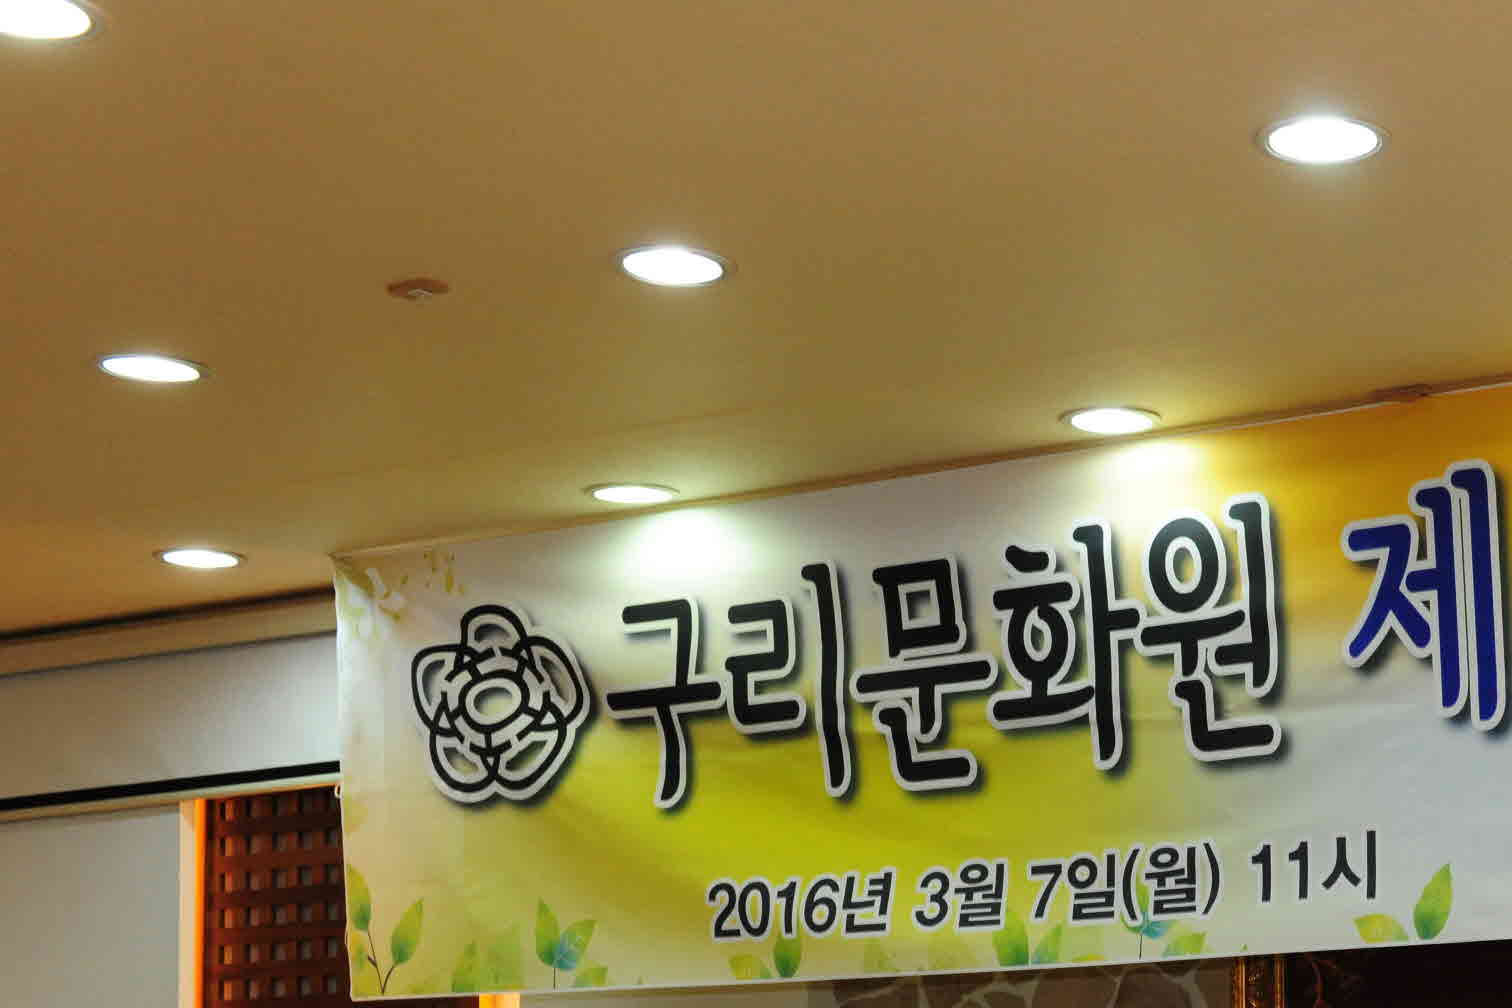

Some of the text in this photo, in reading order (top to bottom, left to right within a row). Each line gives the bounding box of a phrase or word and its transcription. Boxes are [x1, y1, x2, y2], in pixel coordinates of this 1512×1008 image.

[605, 498, 1281, 804] 구리문화원
[1346, 464, 1502, 723] 제
[707, 830, 1377, 938] 2016년 3월 7일(월) 11시
